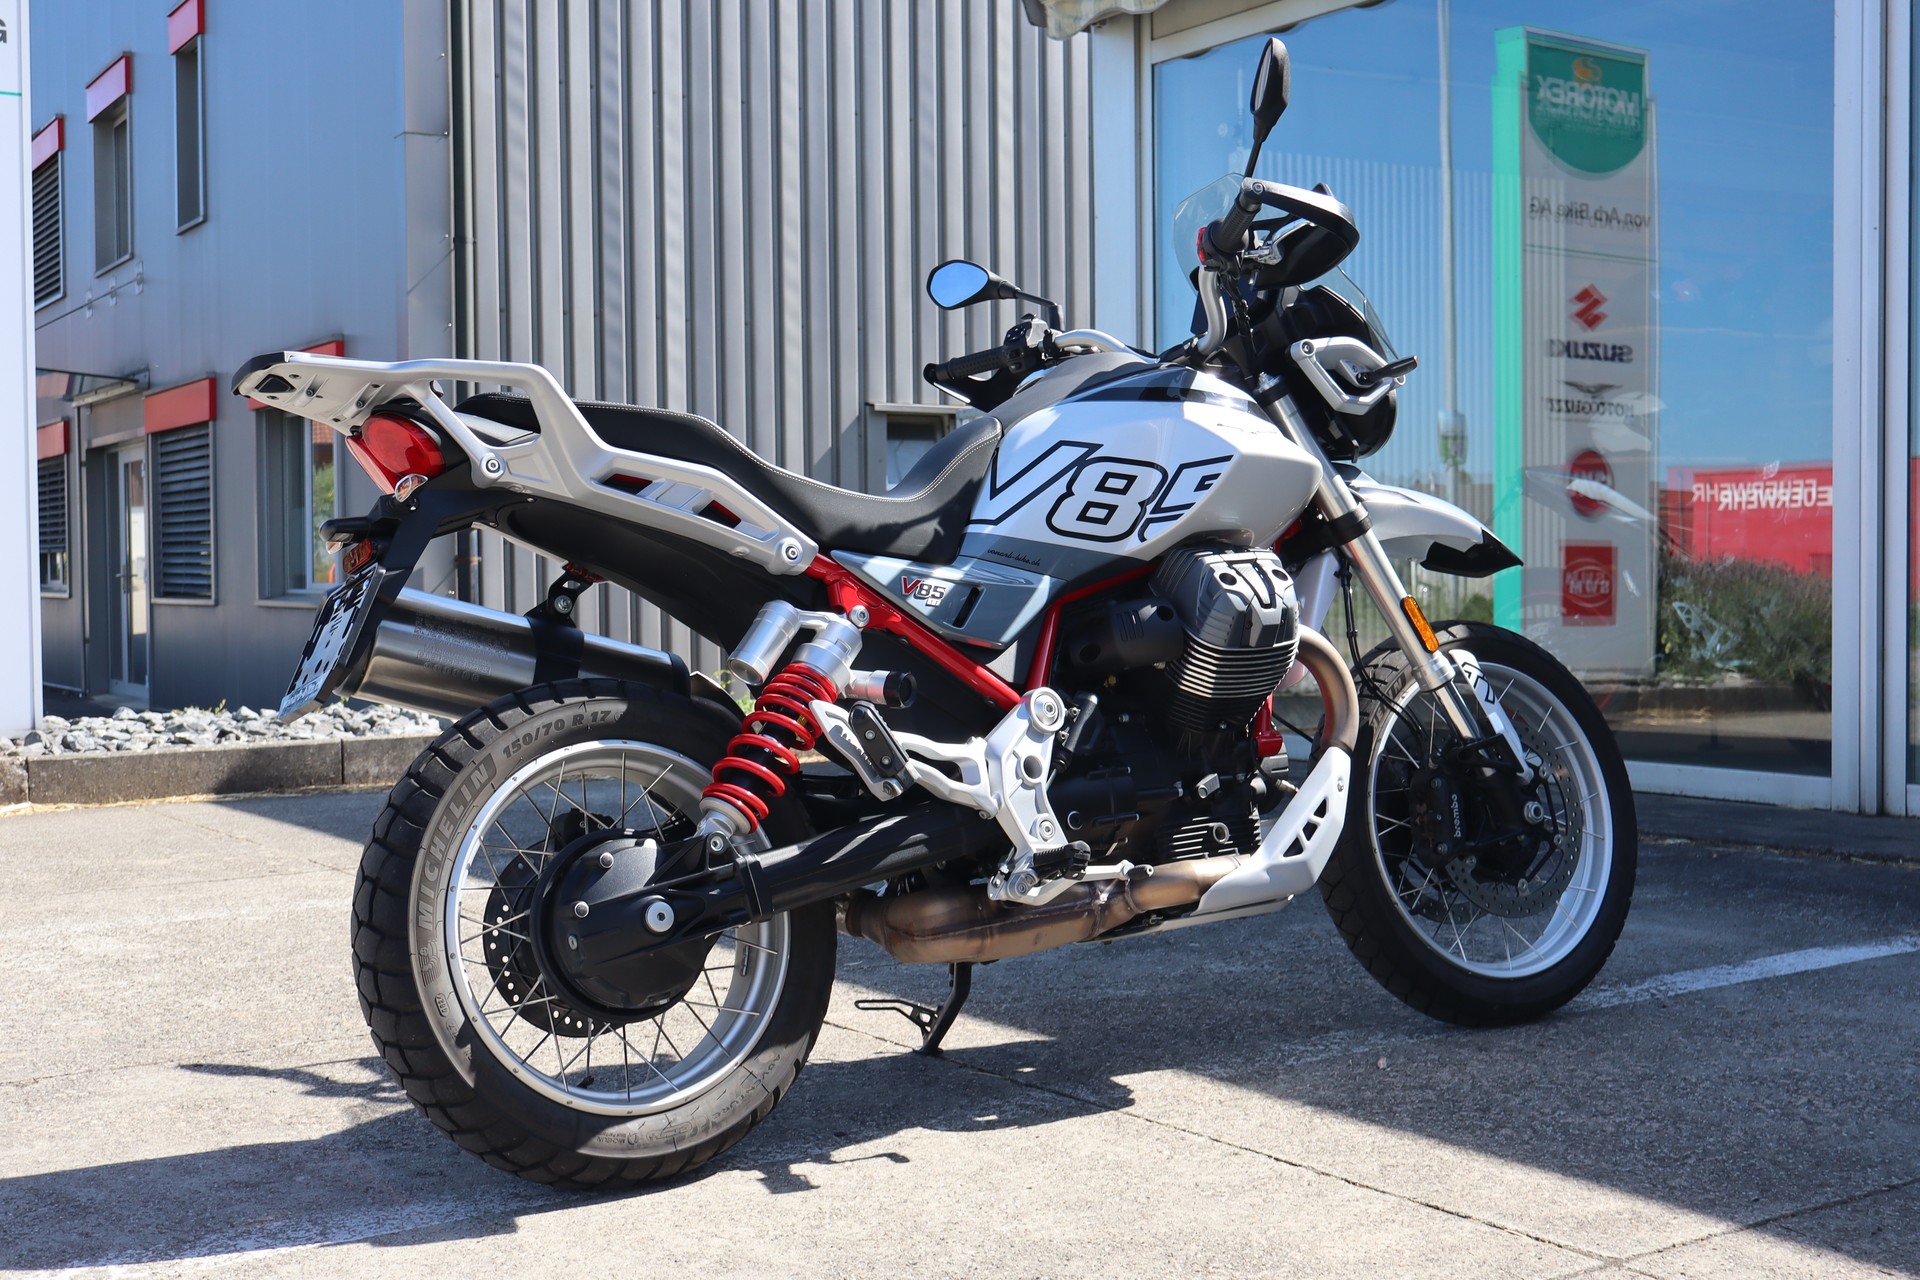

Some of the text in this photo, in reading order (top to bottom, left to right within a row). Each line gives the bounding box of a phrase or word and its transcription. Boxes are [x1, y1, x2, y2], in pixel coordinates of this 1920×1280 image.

[902, 575, 947, 600] V85
[502, 718, 566, 759] 150/70
[571, 713, 585, 727] R
[590, 710, 612, 724] 17
[1451, 793, 1462, 838] brembo
[417, 763, 489, 931] MICHELIN
[711, 1053, 781, 1120] ADVENTURE
